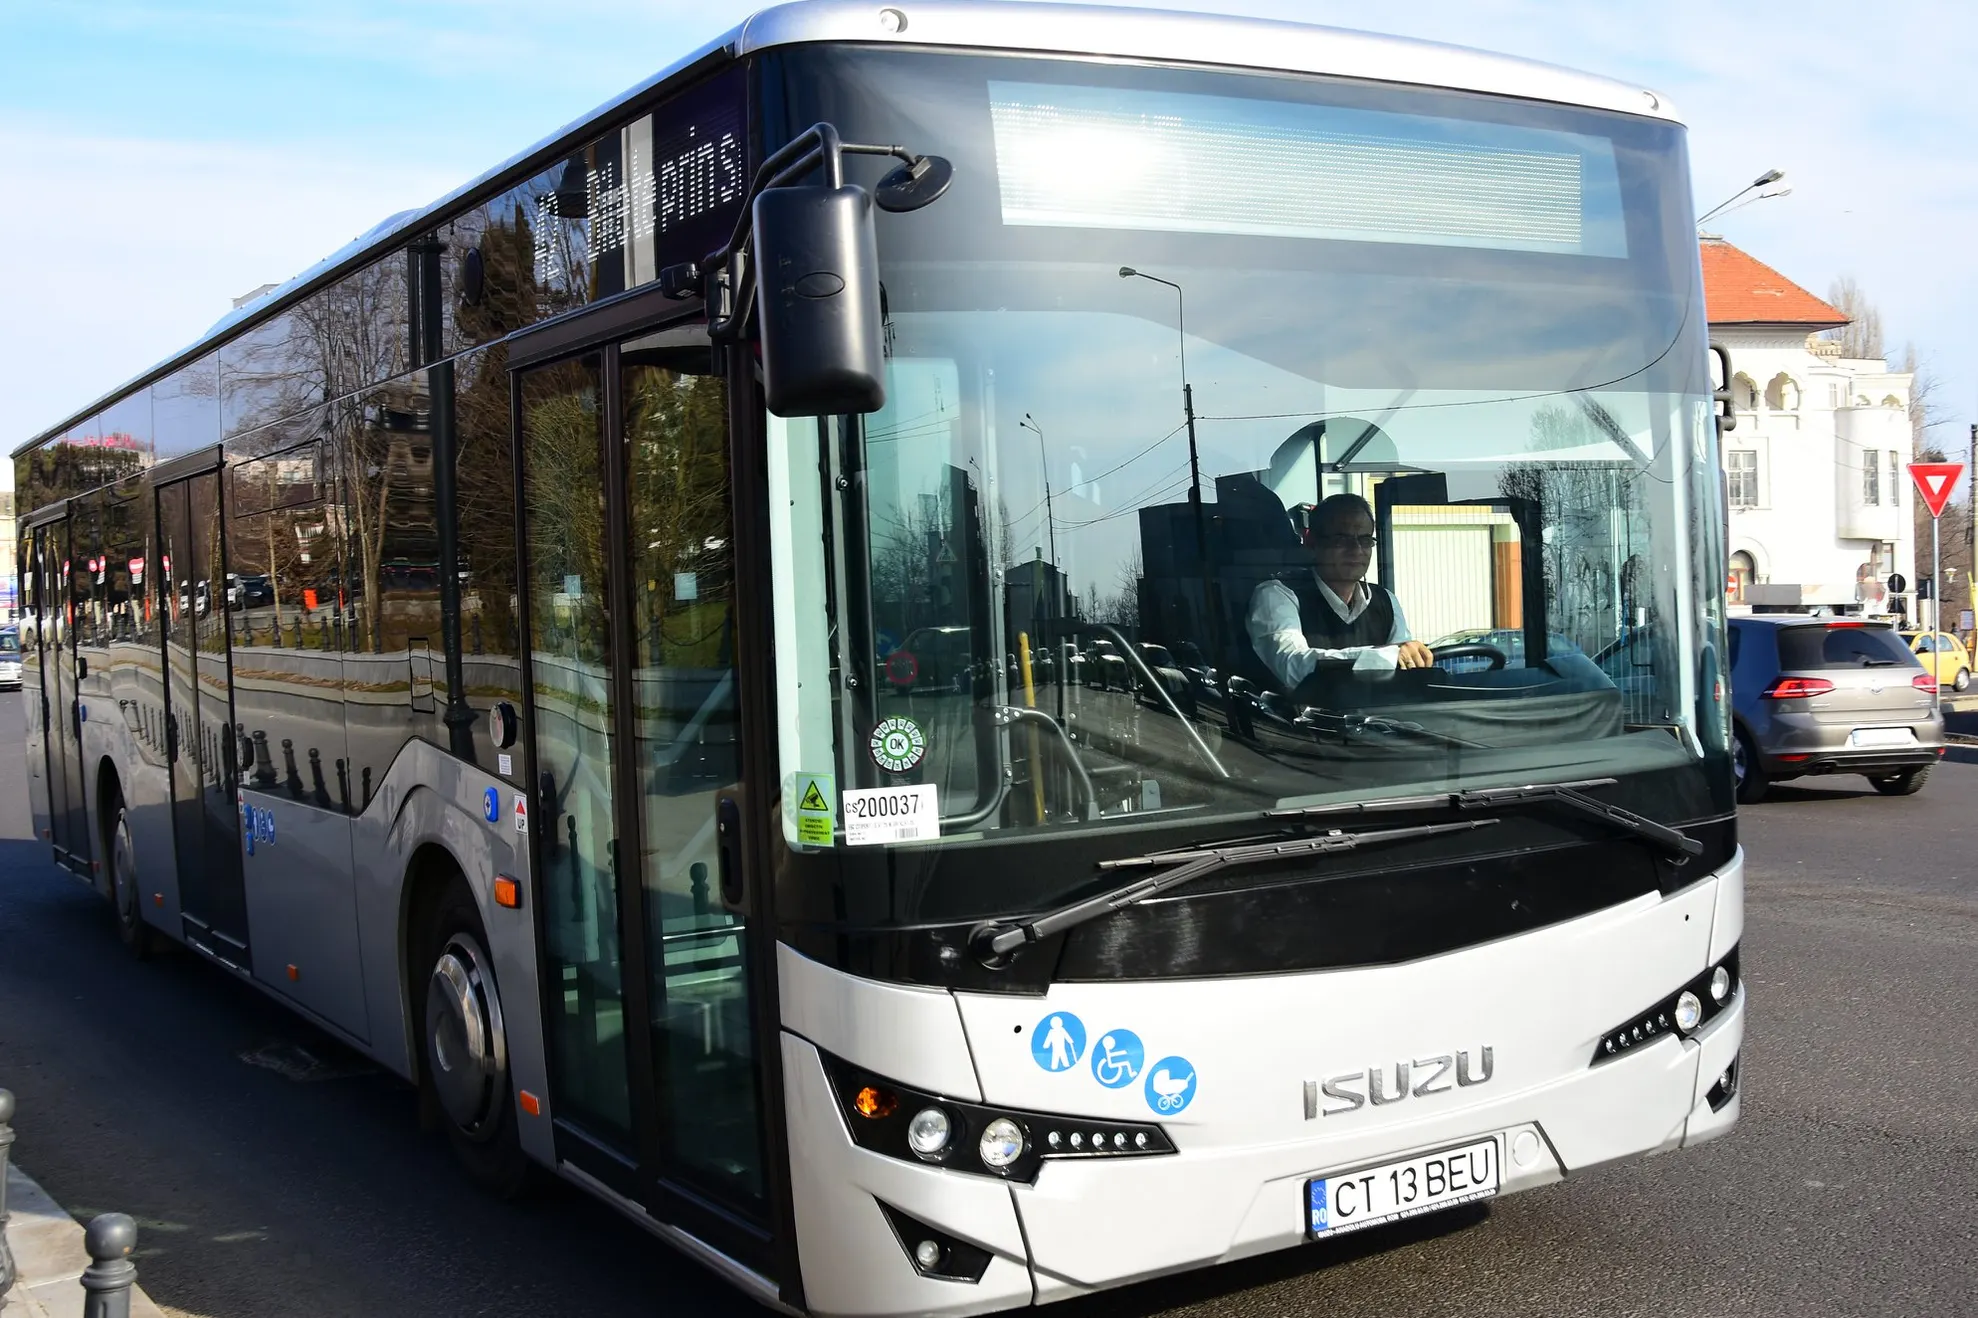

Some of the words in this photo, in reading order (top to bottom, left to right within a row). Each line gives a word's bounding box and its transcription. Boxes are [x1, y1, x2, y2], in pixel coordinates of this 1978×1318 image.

[889, 738, 905, 750] OK
[517, 818, 524, 830] UP
[1303, 1044, 1493, 1120] ISUZU
[1335, 1176, 1375, 1217] CT
[1390, 1167, 1417, 1205] 13
[1425, 1148, 1489, 1197] BEU
[1312, 1207, 1328, 1225] RO
